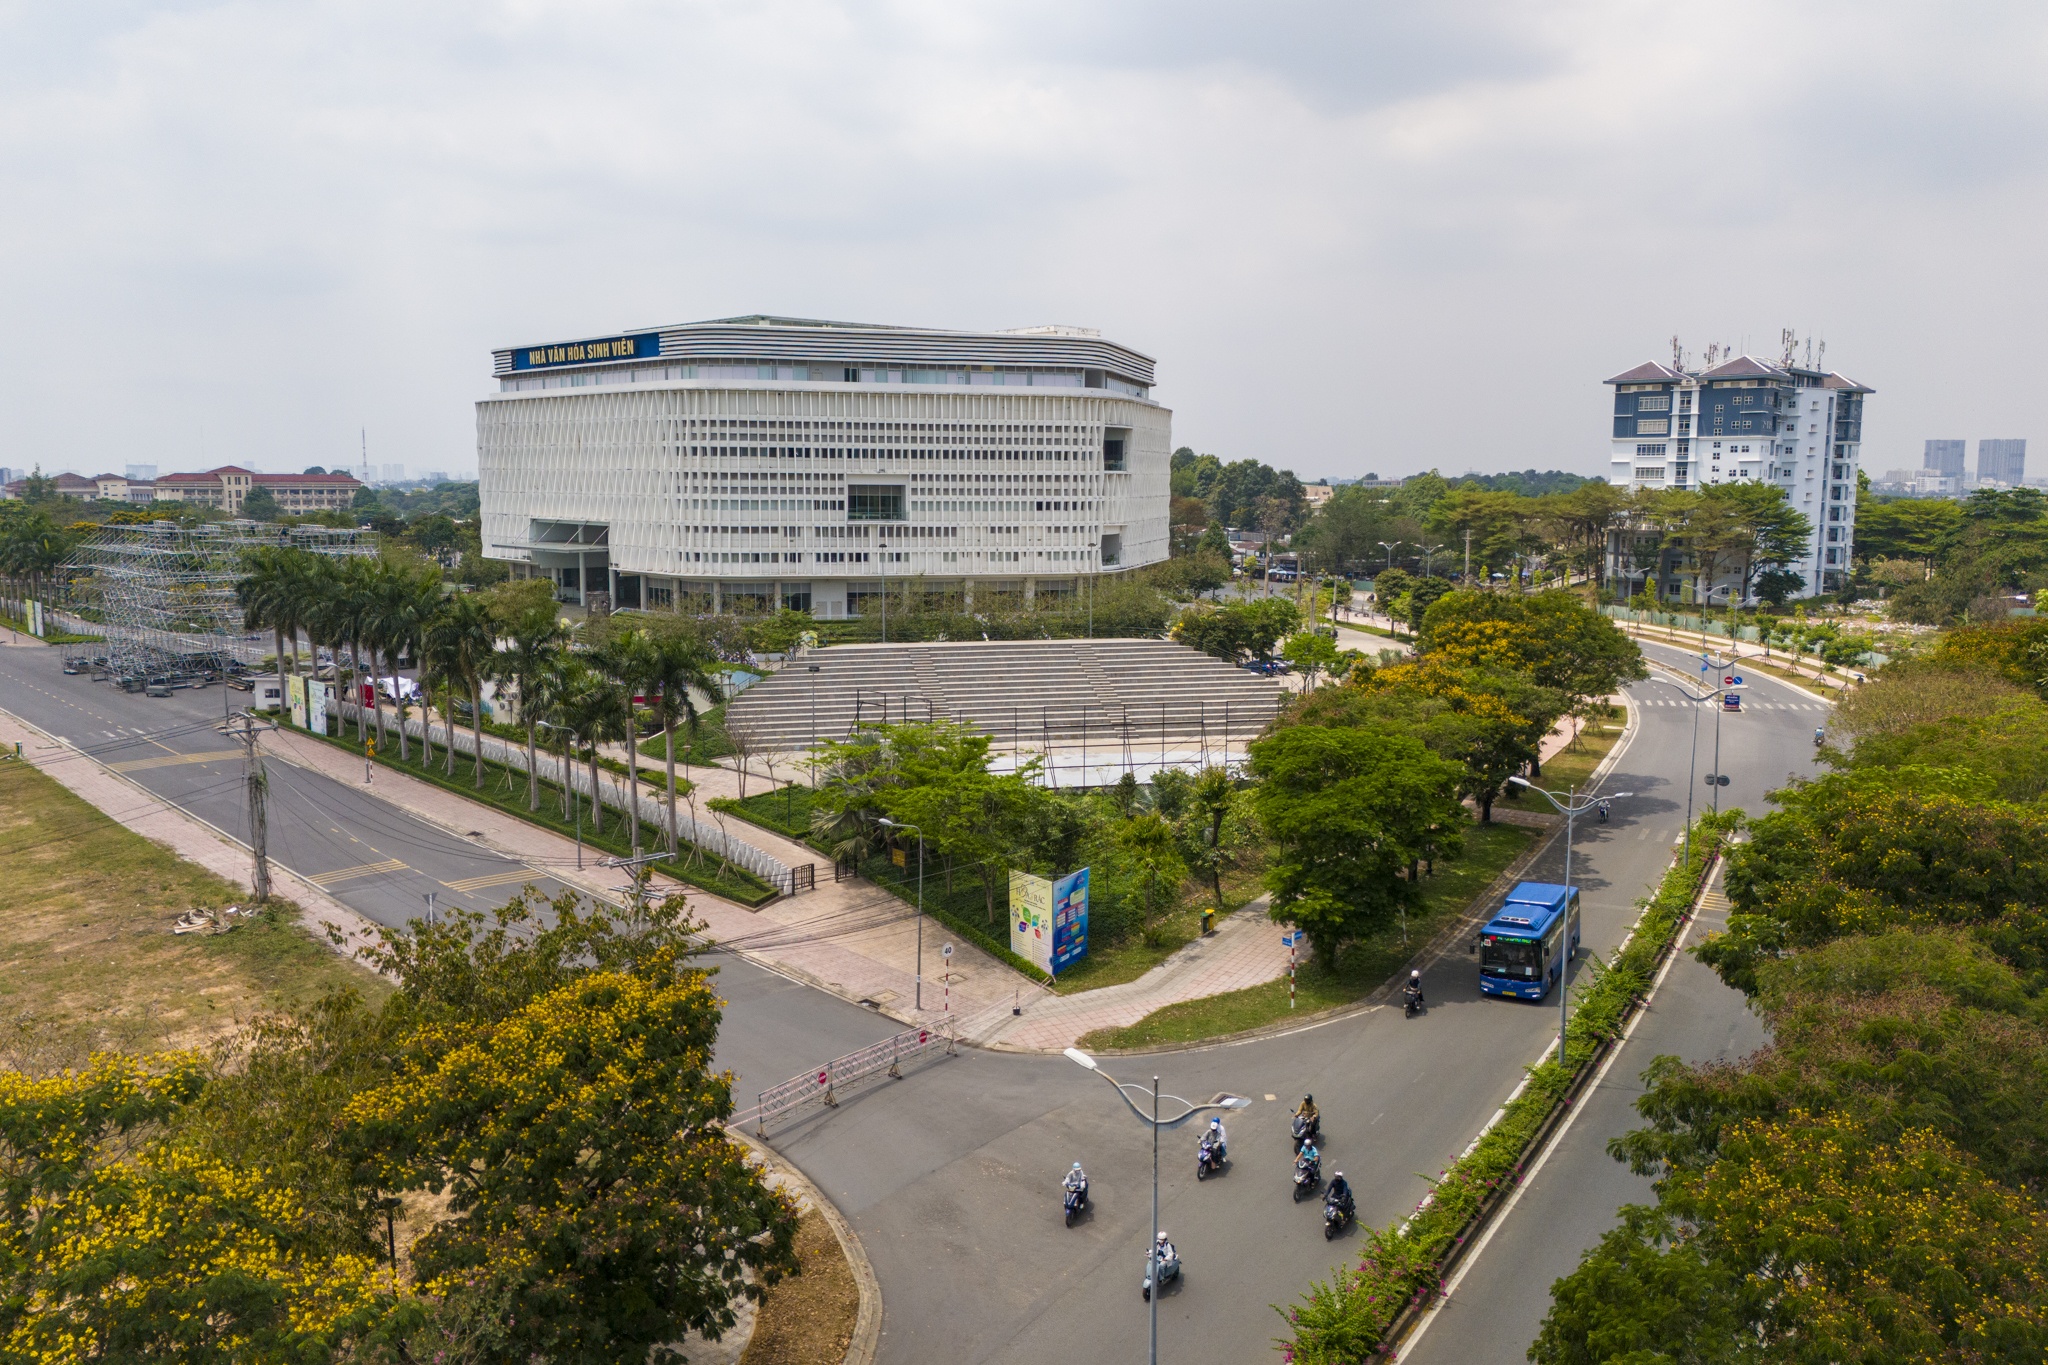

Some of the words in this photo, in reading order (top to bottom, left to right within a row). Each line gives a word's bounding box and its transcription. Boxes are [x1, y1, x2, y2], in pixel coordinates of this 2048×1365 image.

[529, 347, 546, 365] NHÀ
[548, 346, 565, 363] VĂN
[567, 343, 585, 361] HÓA
[587, 343, 610, 359] SINH
[612, 338, 634, 357] VIÊN
